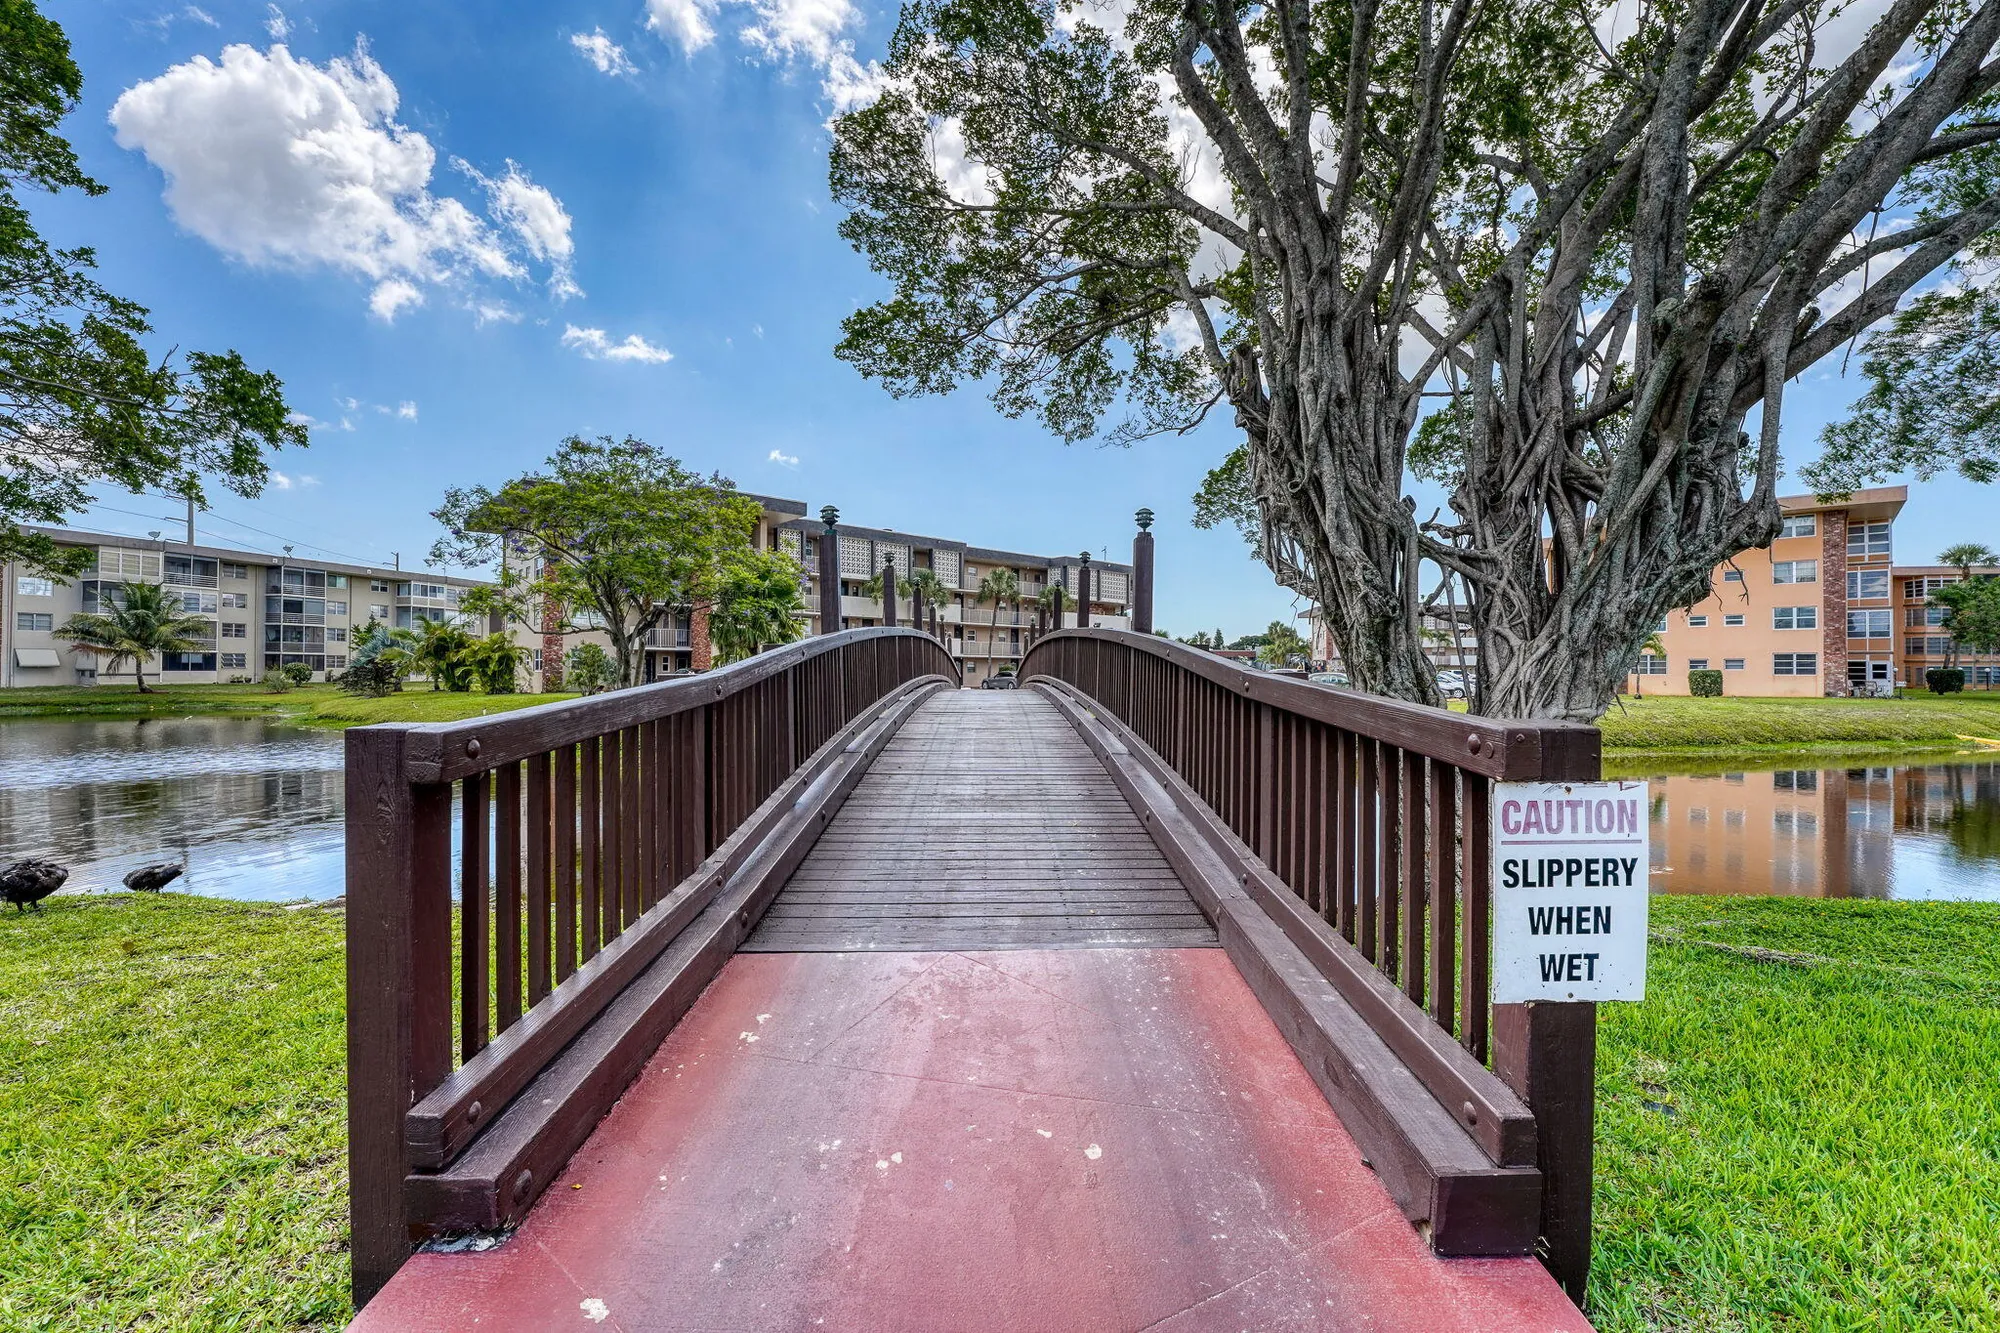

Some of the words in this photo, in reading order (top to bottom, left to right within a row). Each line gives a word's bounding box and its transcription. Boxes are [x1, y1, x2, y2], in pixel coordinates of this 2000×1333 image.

[1501, 799, 1638, 834] CAUTION
[1502, 857, 1639, 889] SLIPPERY
[1528, 906, 1611, 935] WHEN
[1539, 953, 1599, 982] WET
